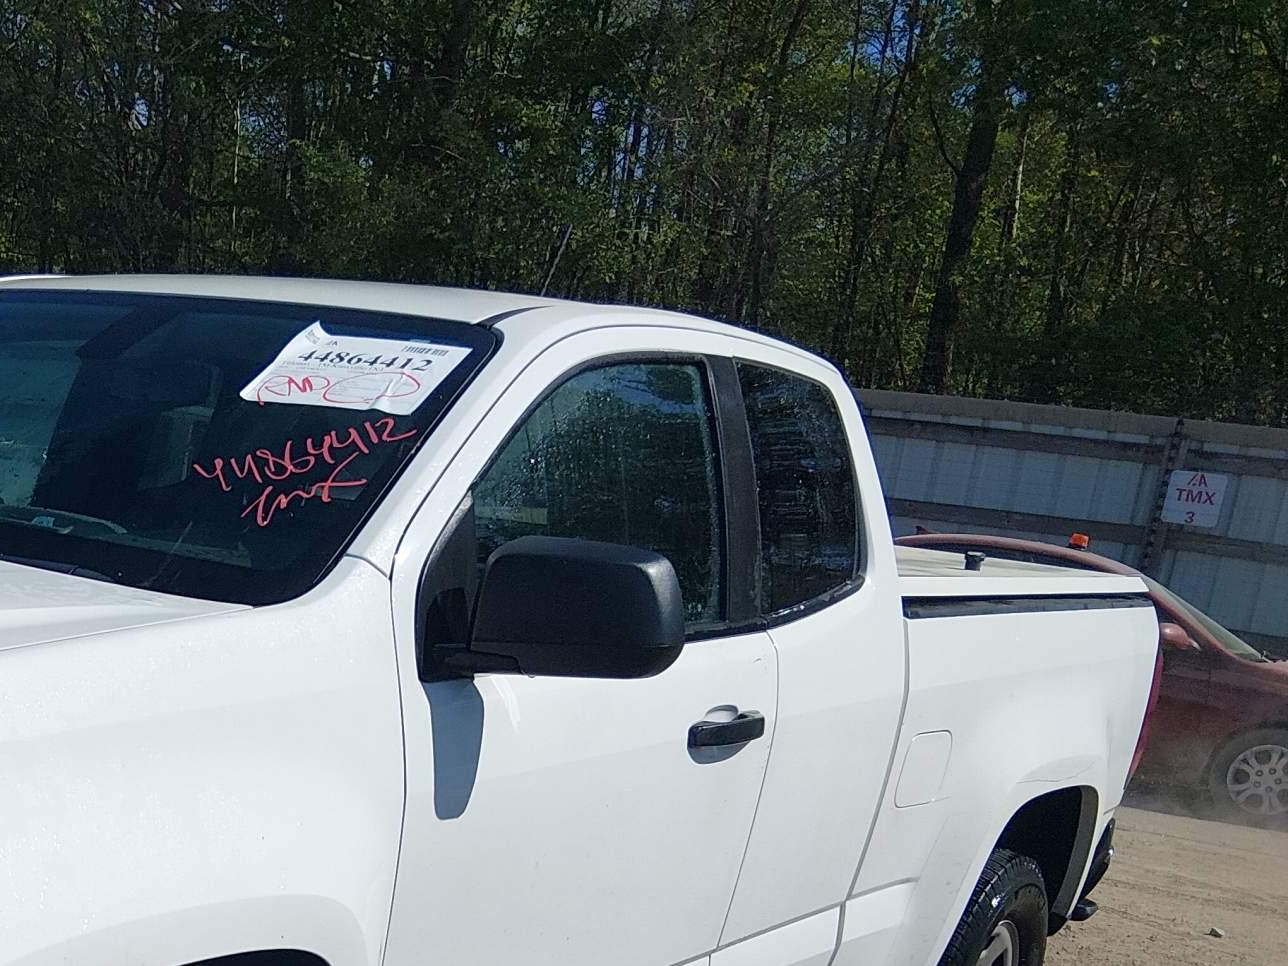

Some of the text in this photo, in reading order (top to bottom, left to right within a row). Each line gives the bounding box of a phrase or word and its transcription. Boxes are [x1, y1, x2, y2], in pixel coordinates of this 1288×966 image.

[298, 350, 433, 372] 44864412
[193, 418, 418, 492] 44864412
[1176, 488, 1216, 505] TMX
[1184, 511, 1195, 524] 3
